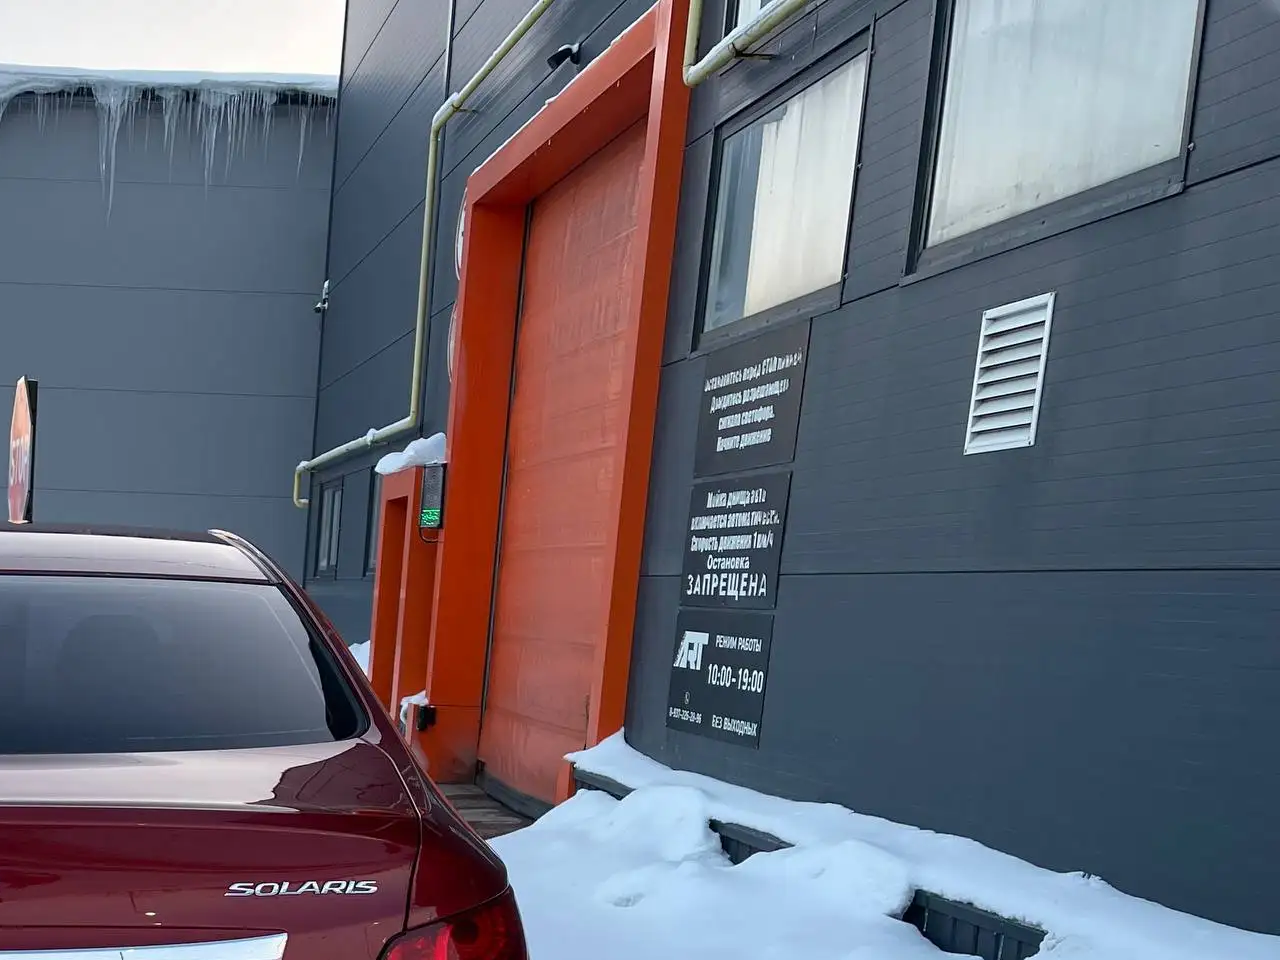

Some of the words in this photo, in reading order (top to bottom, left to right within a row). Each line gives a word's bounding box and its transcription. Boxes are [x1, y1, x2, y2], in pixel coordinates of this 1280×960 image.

[707, 554, 750, 570] Остановка
[686, 573, 767, 600] ЗАПРЕЩЕНА
[715, 635, 738, 650] РЕЖИМ
[738, 637, 763, 652] РАБОТЫ
[711, 714, 723, 729] БЕЗ
[723, 717, 758, 736] ВЫХОДНЫХ
[224, 880, 378, 897] SOLARIS
